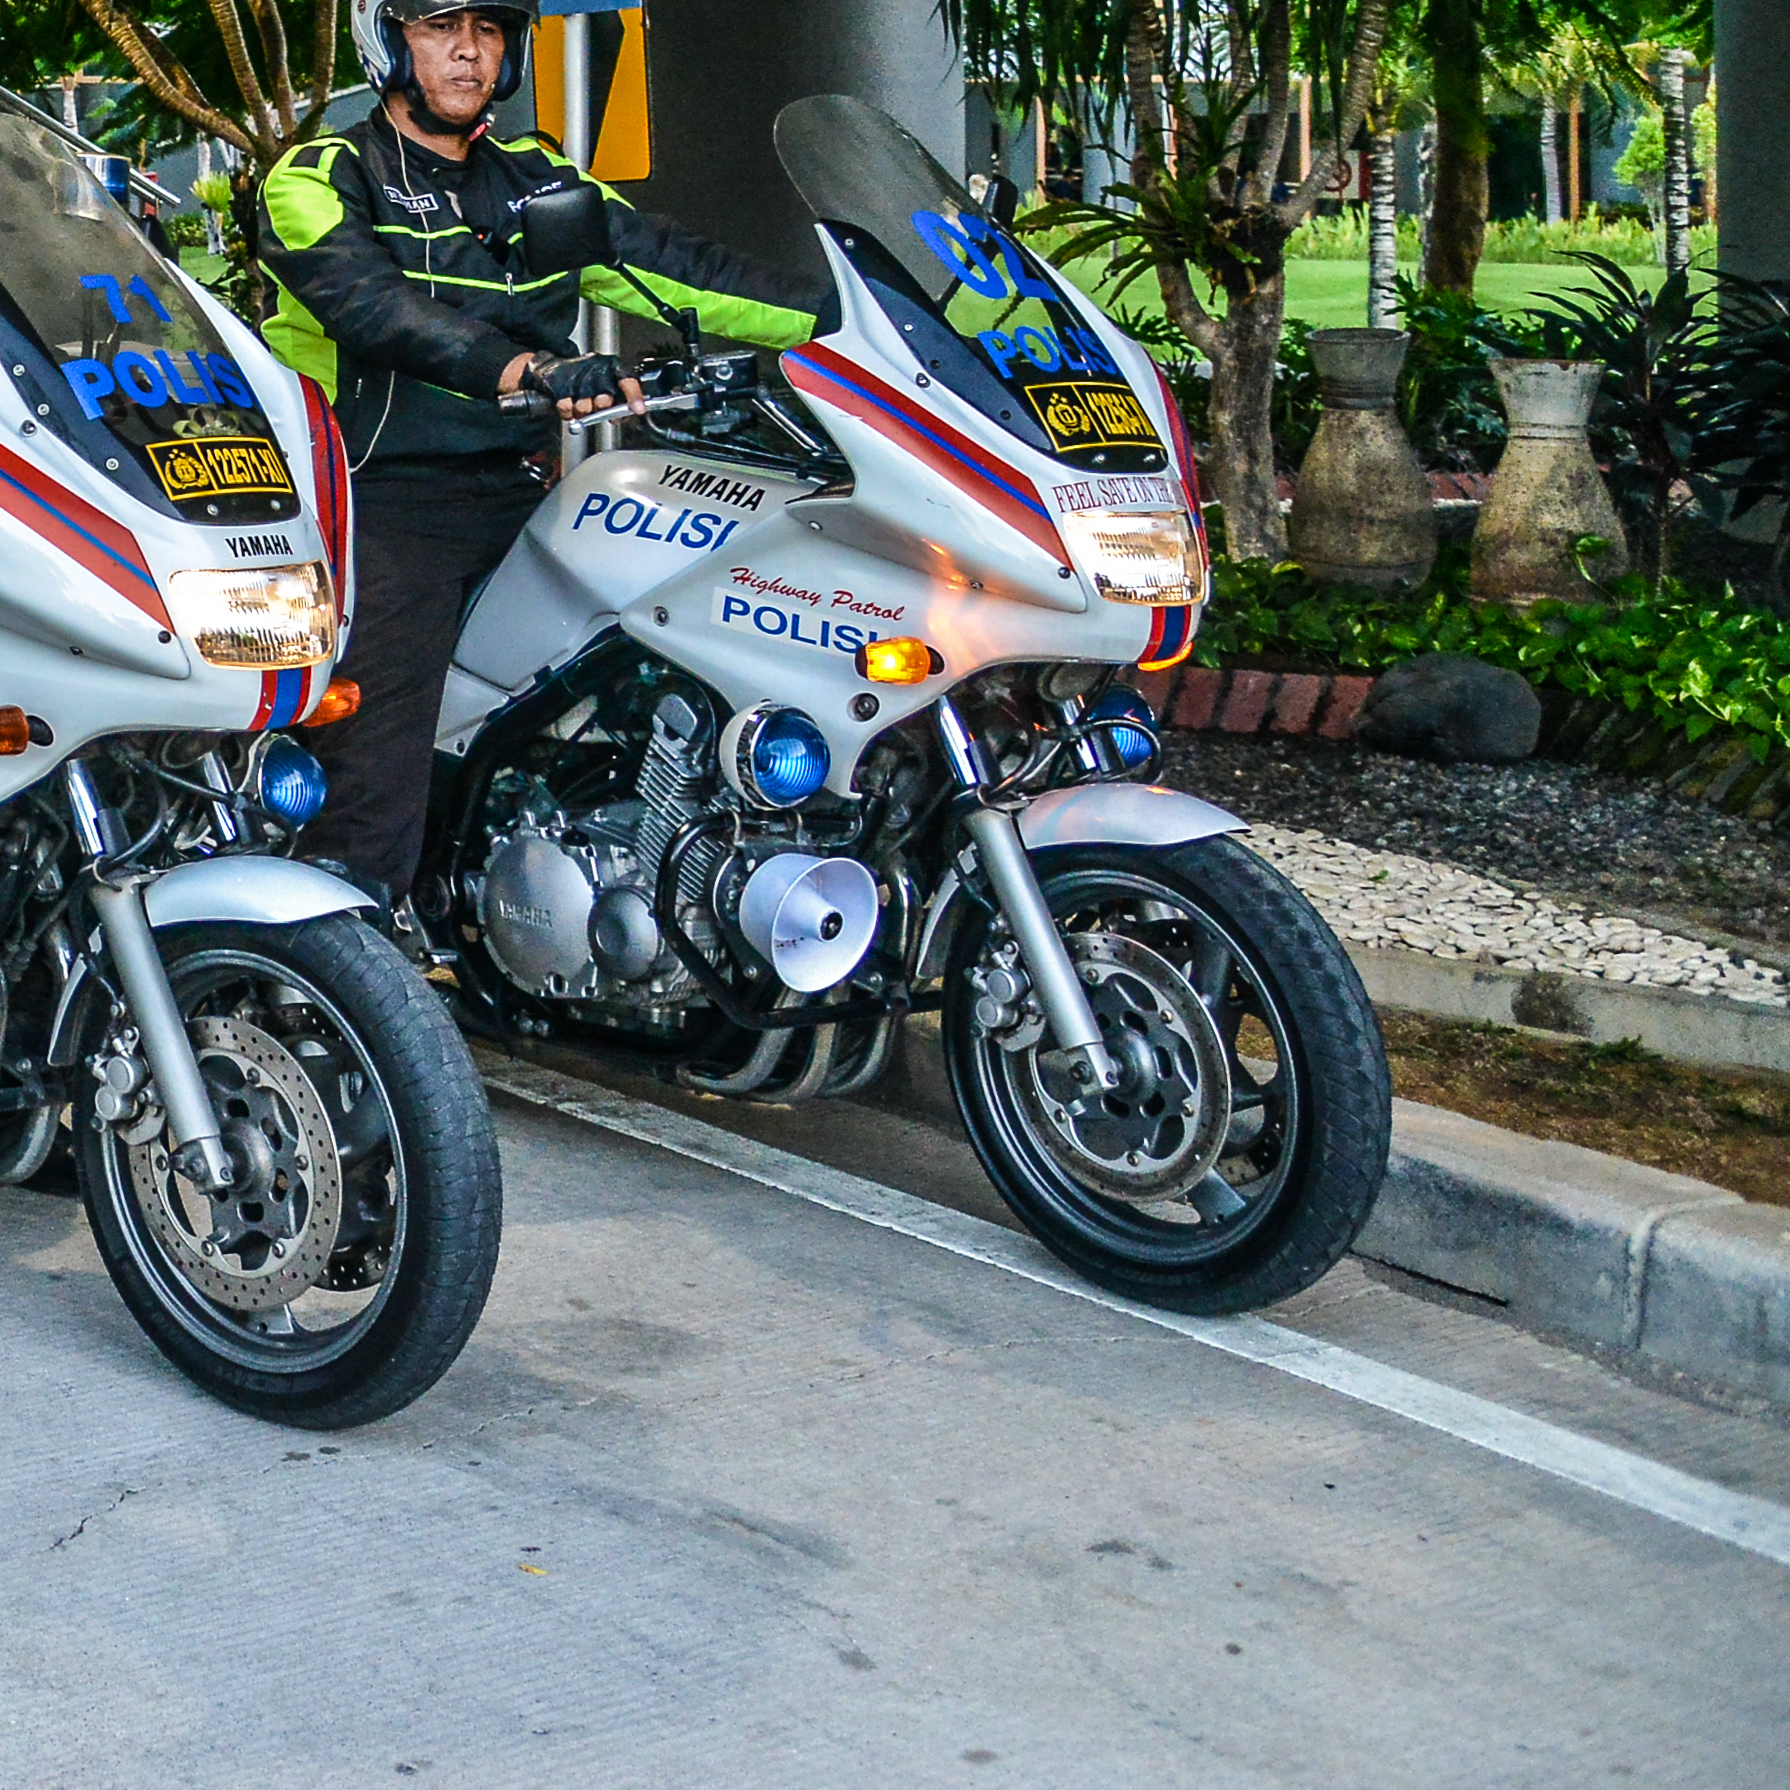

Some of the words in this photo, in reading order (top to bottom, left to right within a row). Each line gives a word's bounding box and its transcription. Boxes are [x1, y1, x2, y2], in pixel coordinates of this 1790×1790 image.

[911, 209, 1060, 302] 02
[79, 274, 173, 324] 71
[659, 464, 766, 512] YAMAHA
[1052, 481, 1102, 513] FEEL
[1097, 479, 1138, 507] SAVE
[224, 534, 294, 559] YAMAHA
[730, 566, 822, 607] Highway
[831, 589, 905, 621] Patrol
